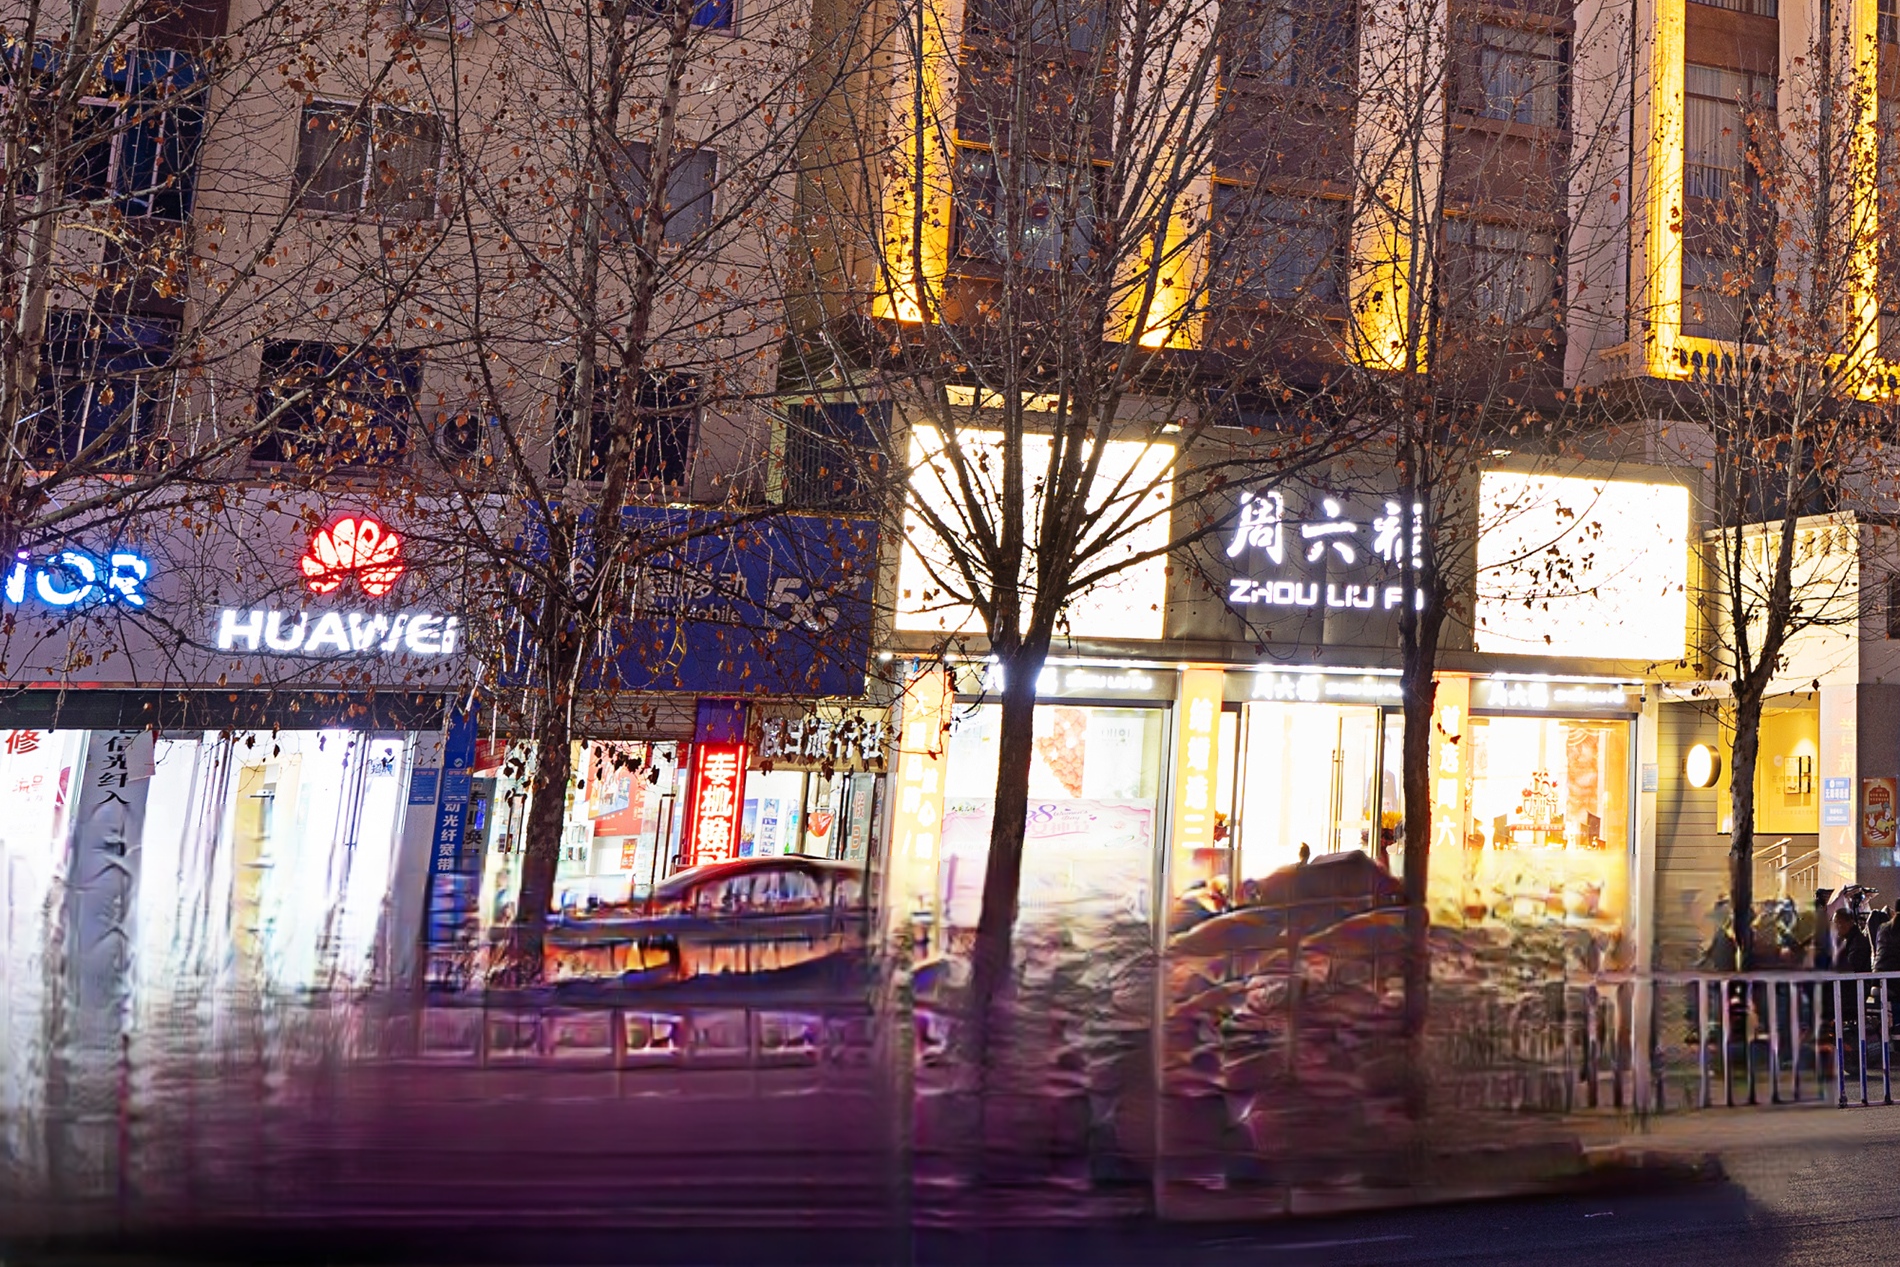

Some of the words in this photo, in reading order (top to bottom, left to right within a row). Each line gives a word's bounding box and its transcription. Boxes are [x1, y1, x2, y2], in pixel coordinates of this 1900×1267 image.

[1229, 578, 1319, 606] ZHOU
[1326, 583, 1375, 609] LIU
[218, 608, 458, 654] HUAWEI
